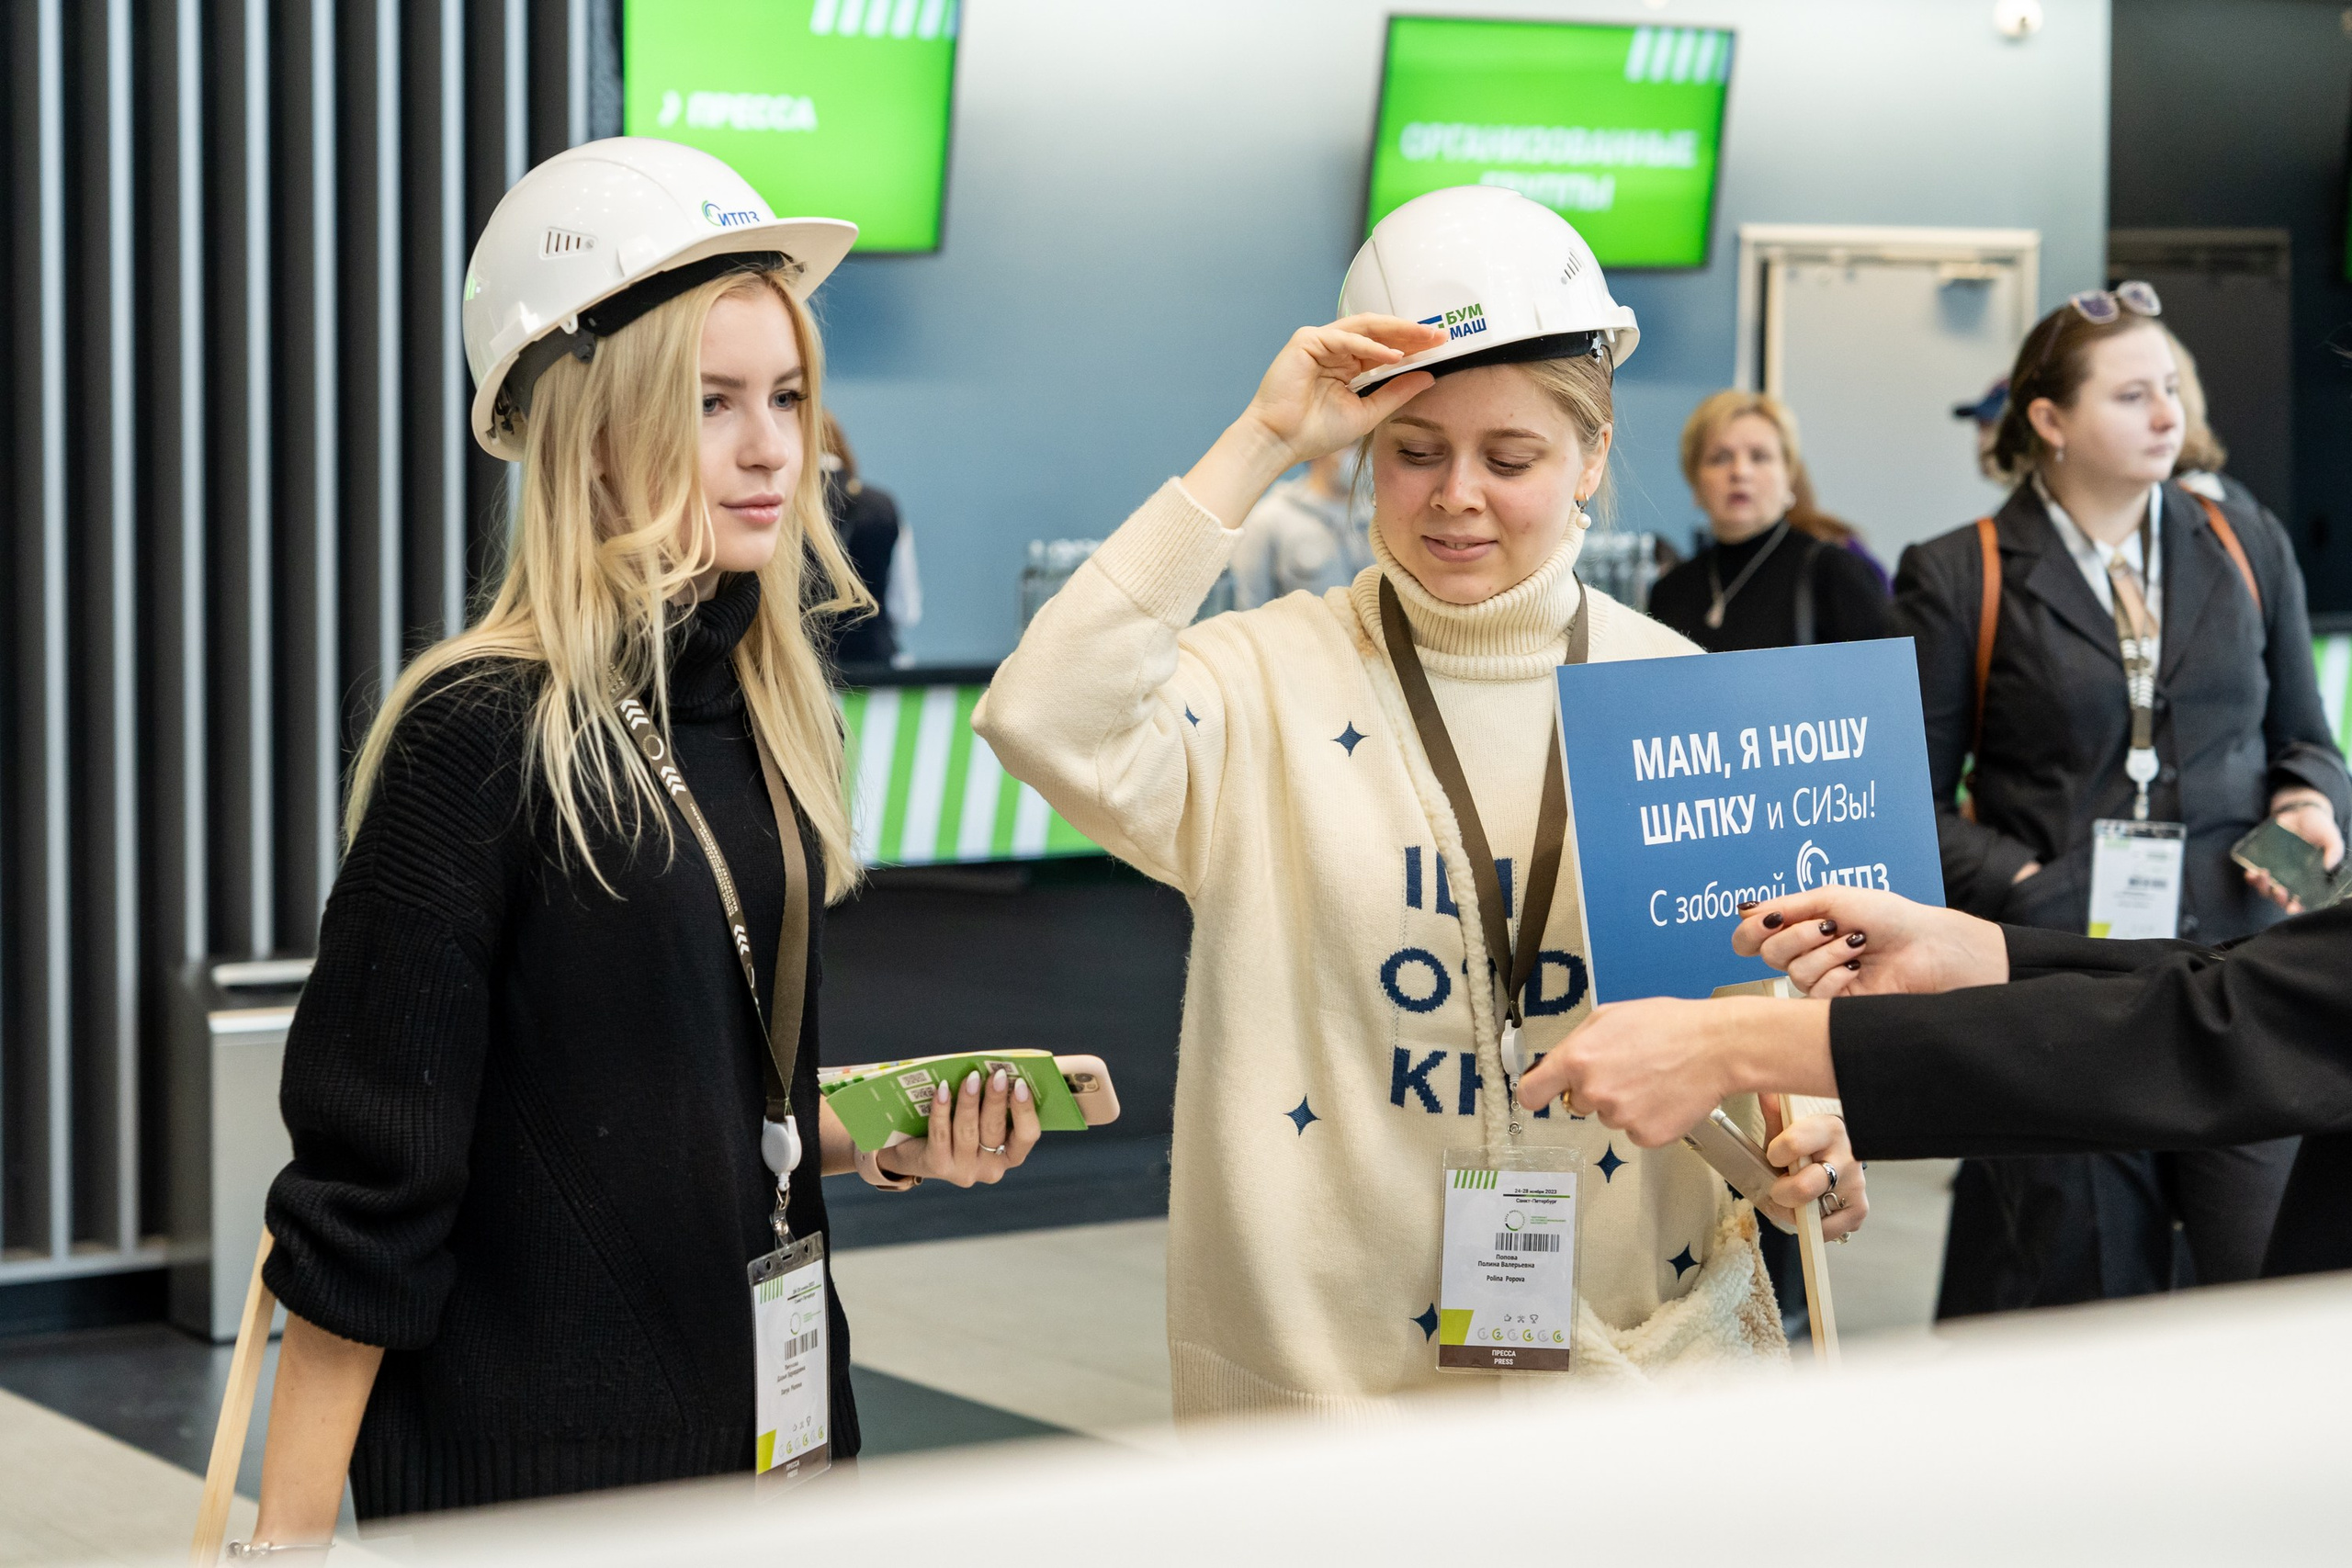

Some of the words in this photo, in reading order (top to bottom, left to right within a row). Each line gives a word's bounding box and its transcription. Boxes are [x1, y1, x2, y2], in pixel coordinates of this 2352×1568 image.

[685, 92, 818, 130] ПРЕССА
[1445, 303, 1483, 325] БУМ
[1449, 318, 1487, 340] МАШ
[1632, 731, 1731, 781] МАМ,
[1739, 728, 1761, 770] Я
[1770, 716, 1868, 766] НОШУ
[1640, 794, 1757, 846] ШАПКУ
[1767, 802, 1784, 830] и
[1792, 780, 1876, 827] СИЗы!
[1649, 889, 1668, 927] С
